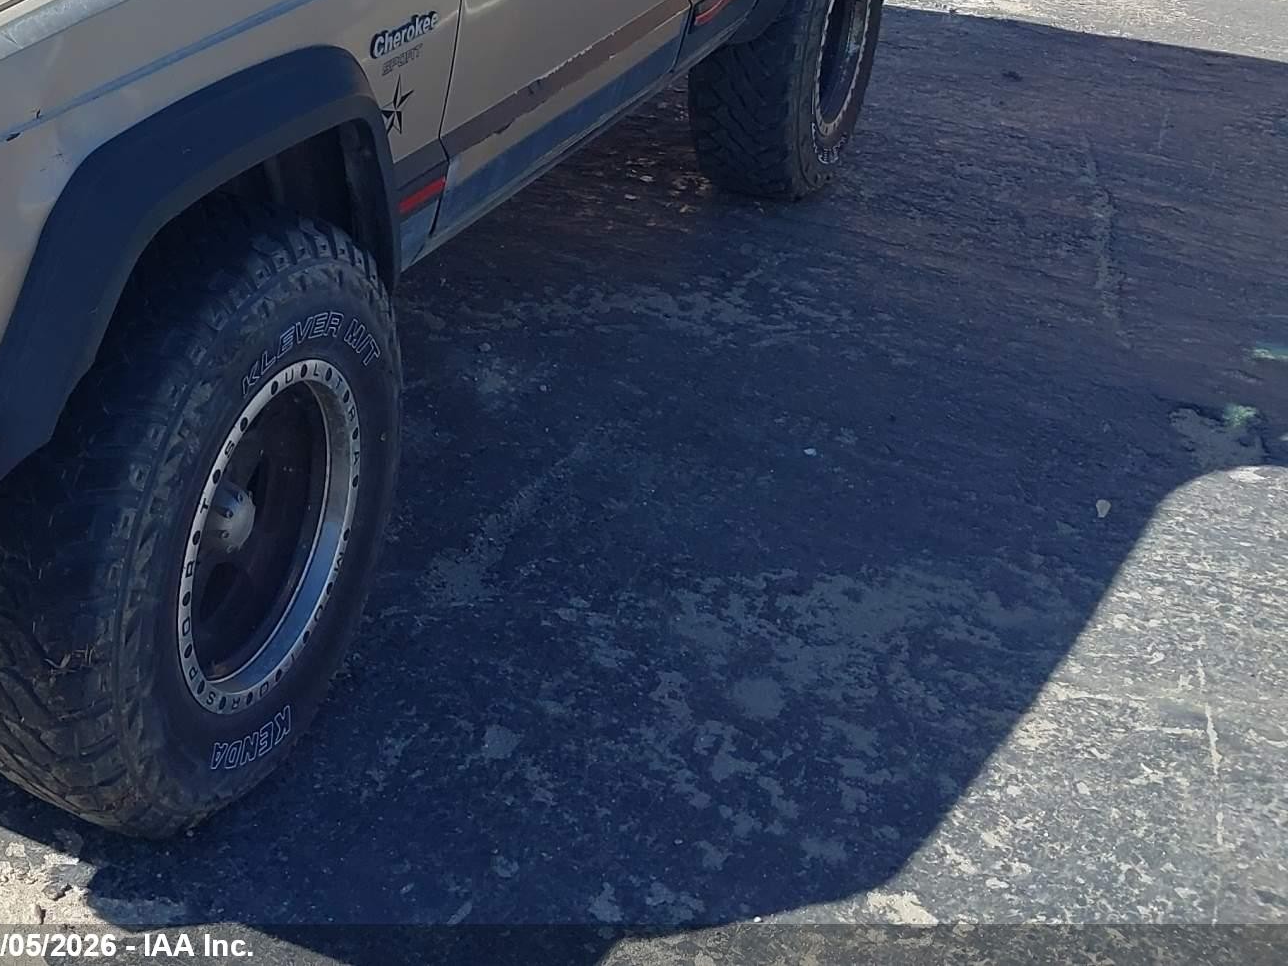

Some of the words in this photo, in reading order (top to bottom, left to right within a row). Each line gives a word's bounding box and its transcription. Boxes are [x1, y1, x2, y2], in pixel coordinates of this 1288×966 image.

[369, 10, 440, 60] Cherokee
[240, 310, 345, 398] KLEVER
[210, 704, 292, 770] KENDA
